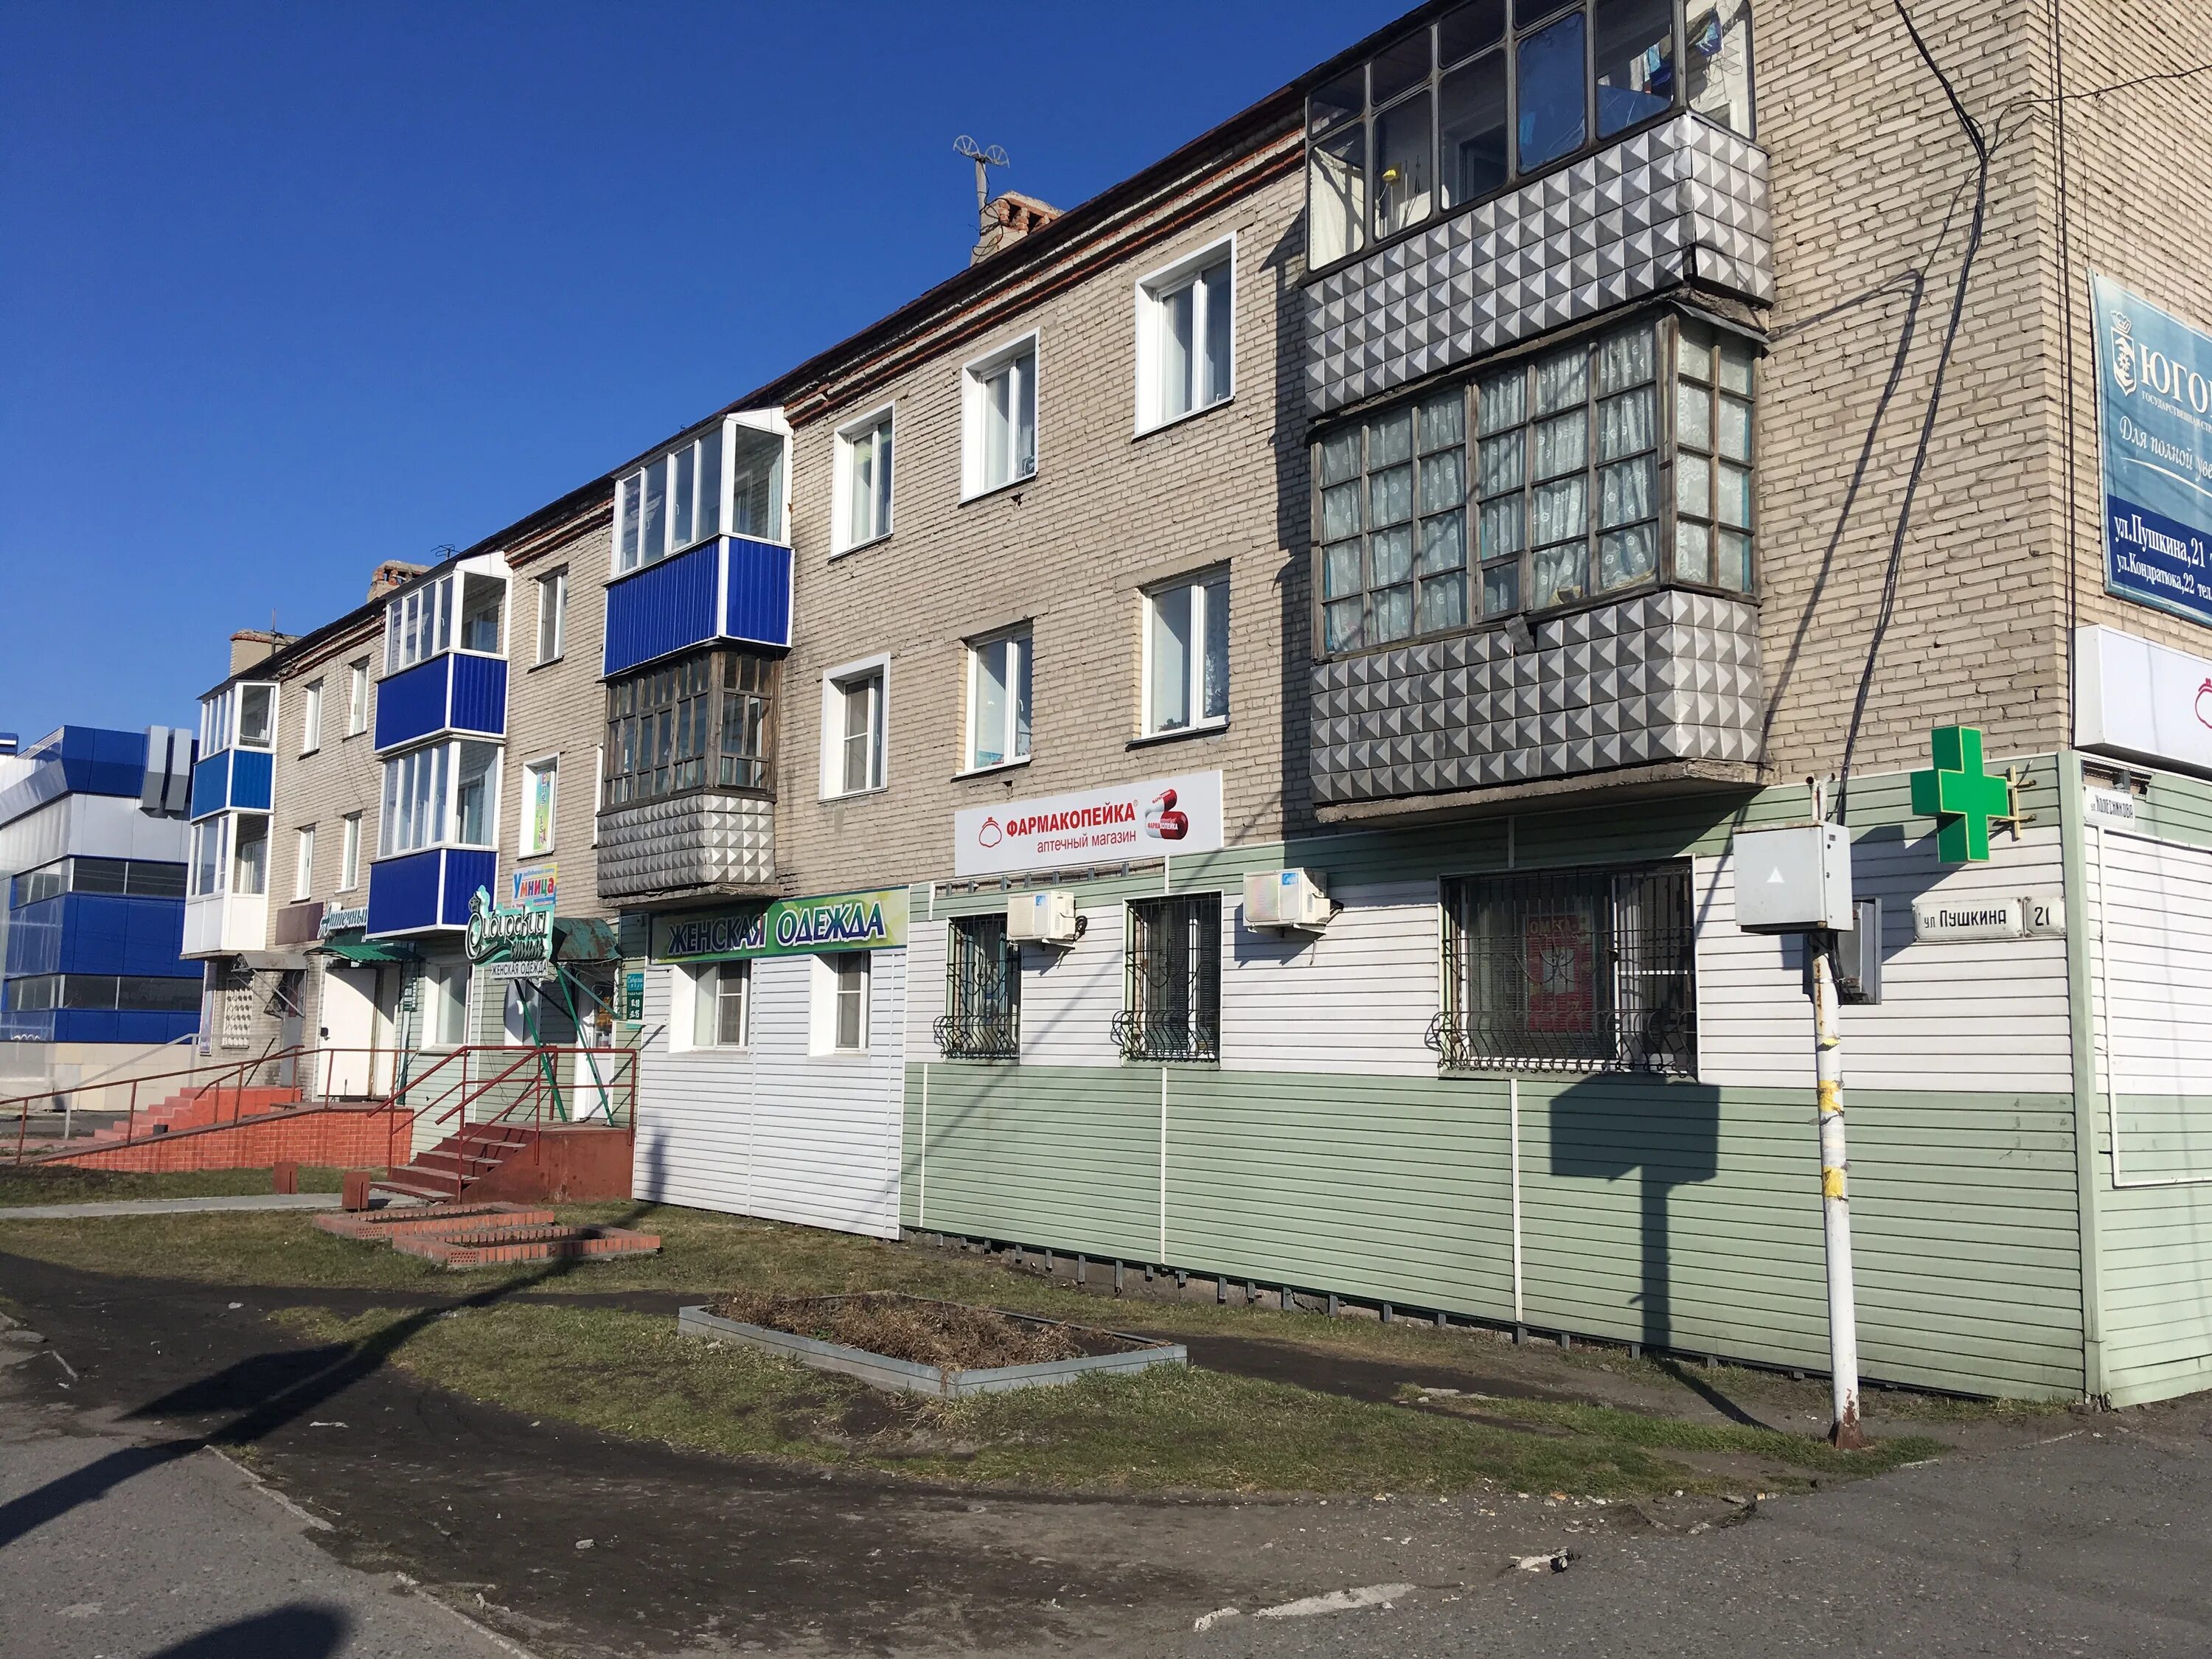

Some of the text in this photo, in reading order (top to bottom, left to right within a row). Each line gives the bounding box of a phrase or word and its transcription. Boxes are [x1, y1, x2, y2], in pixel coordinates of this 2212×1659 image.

[2138, 342, 2212, 418] ЮГО
[2142, 391, 2199, 427] ГОСУДАРСТВЕННАЯ
[2120, 416, 2147, 448] Для
[2150, 436, 2193, 470] полной
[2114, 513, 2205, 568] ул.Пушкина,21
[2116, 552, 2195, 595] ул.Кондратюка,22
[1006, 801, 1135, 837] ФАРМАКОПЕЙКА
[1037, 830, 1136, 853] аптечный магазин
[513, 872, 554, 899] Умница
[667, 900, 886, 956] ЖЕНСКАЯ ОДЕЖДА
[1924, 917, 1935, 928] ул
[2034, 906, 2050, 927] 21
[491, 960, 547, 975] ЖЕНСКАЯ ОДЕЖДА
